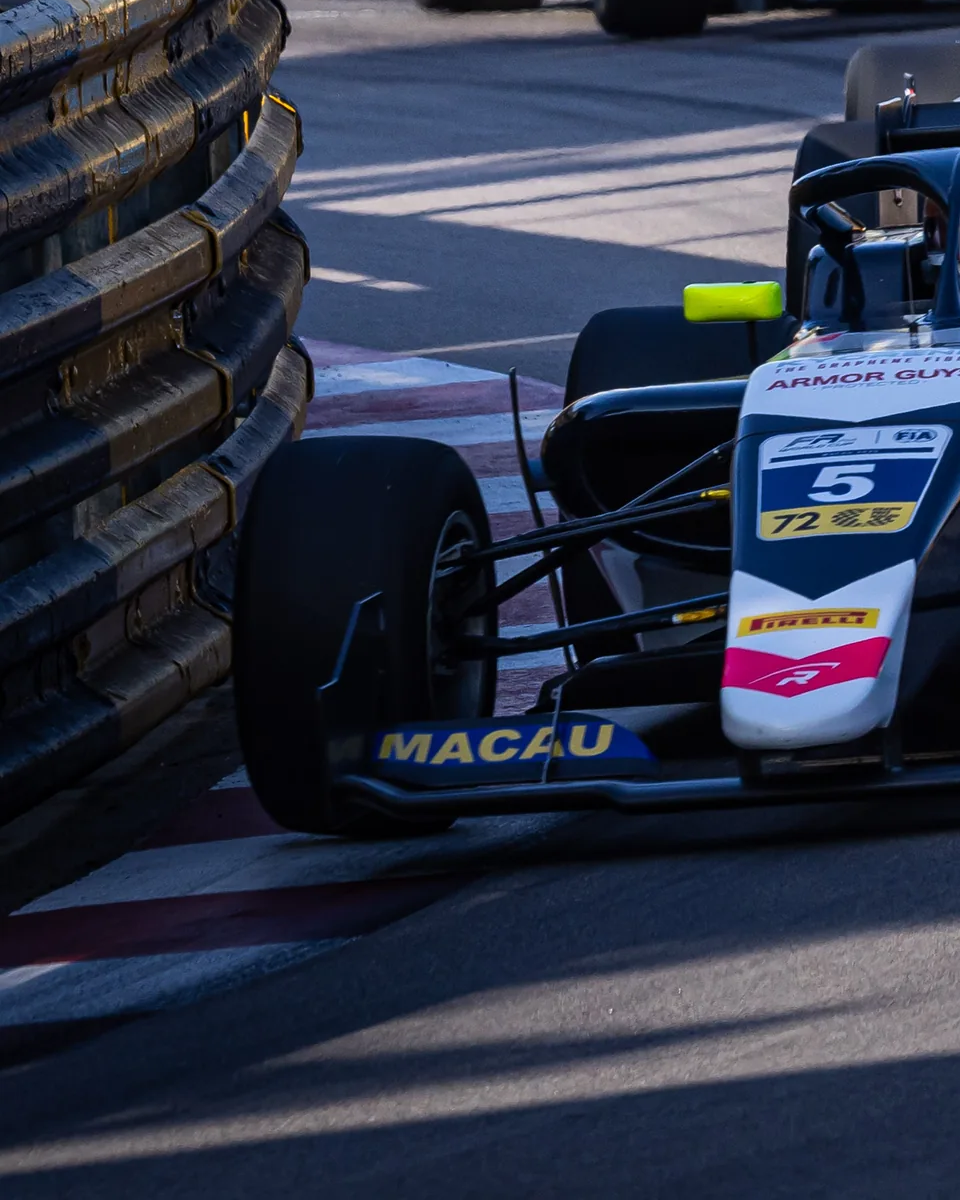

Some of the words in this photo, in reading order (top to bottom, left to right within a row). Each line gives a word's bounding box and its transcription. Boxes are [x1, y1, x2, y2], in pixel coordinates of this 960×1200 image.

[775, 365, 806, 374] THE
[765, 371, 885, 391] ARMOR
[900, 430, 931, 442] FIA
[807, 463, 876, 503] 5
[771, 511, 820, 535] 72
[749, 611, 868, 631] PIRELLI
[378, 723, 615, 765] MACAU
